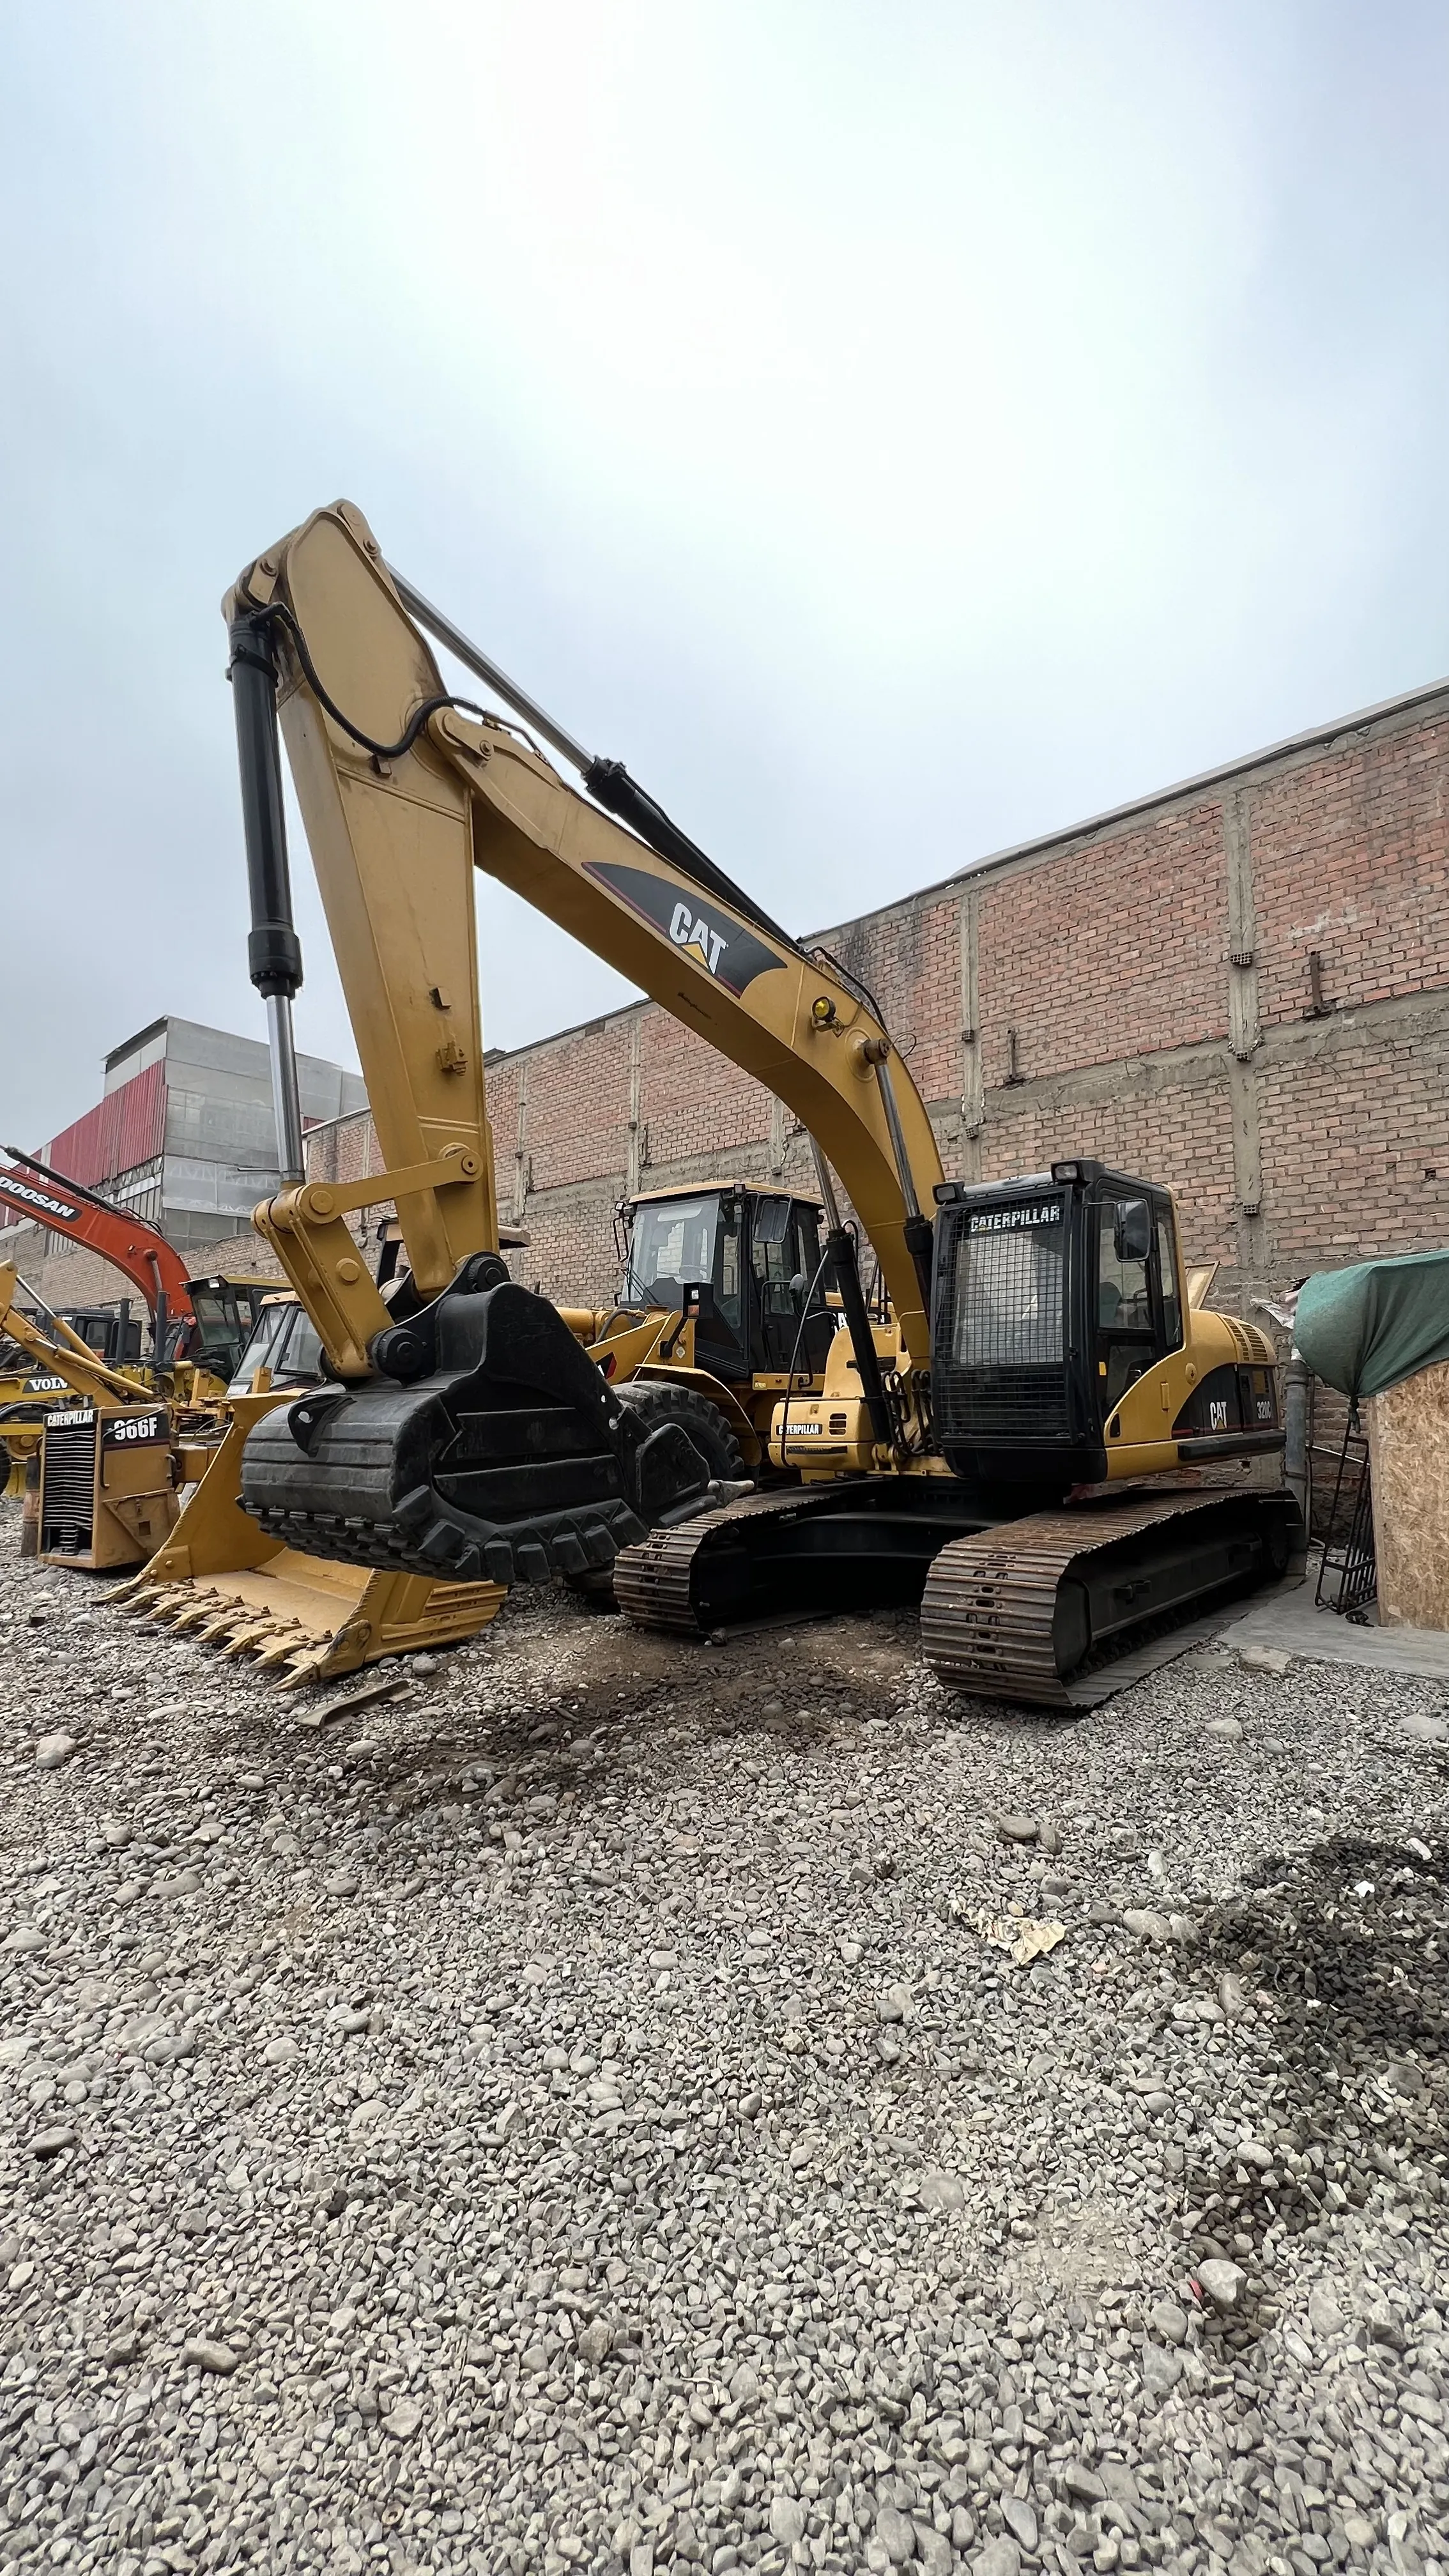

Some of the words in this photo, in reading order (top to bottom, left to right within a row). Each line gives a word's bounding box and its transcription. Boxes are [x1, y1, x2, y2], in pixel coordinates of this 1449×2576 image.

[670, 902, 727, 974] CAT
[0, 1176, 75, 1217] DOOSAN
[970, 1206, 1061, 1233] CATERPILLAR
[29, 1377, 68, 1391] VOLV
[47, 1409, 94, 1427] CATERPILLAR
[114, 1416, 157, 1441] 966F
[1210, 1401, 1227, 1430] CAT
[778, 1424, 819, 1434] CTERPILLAR
